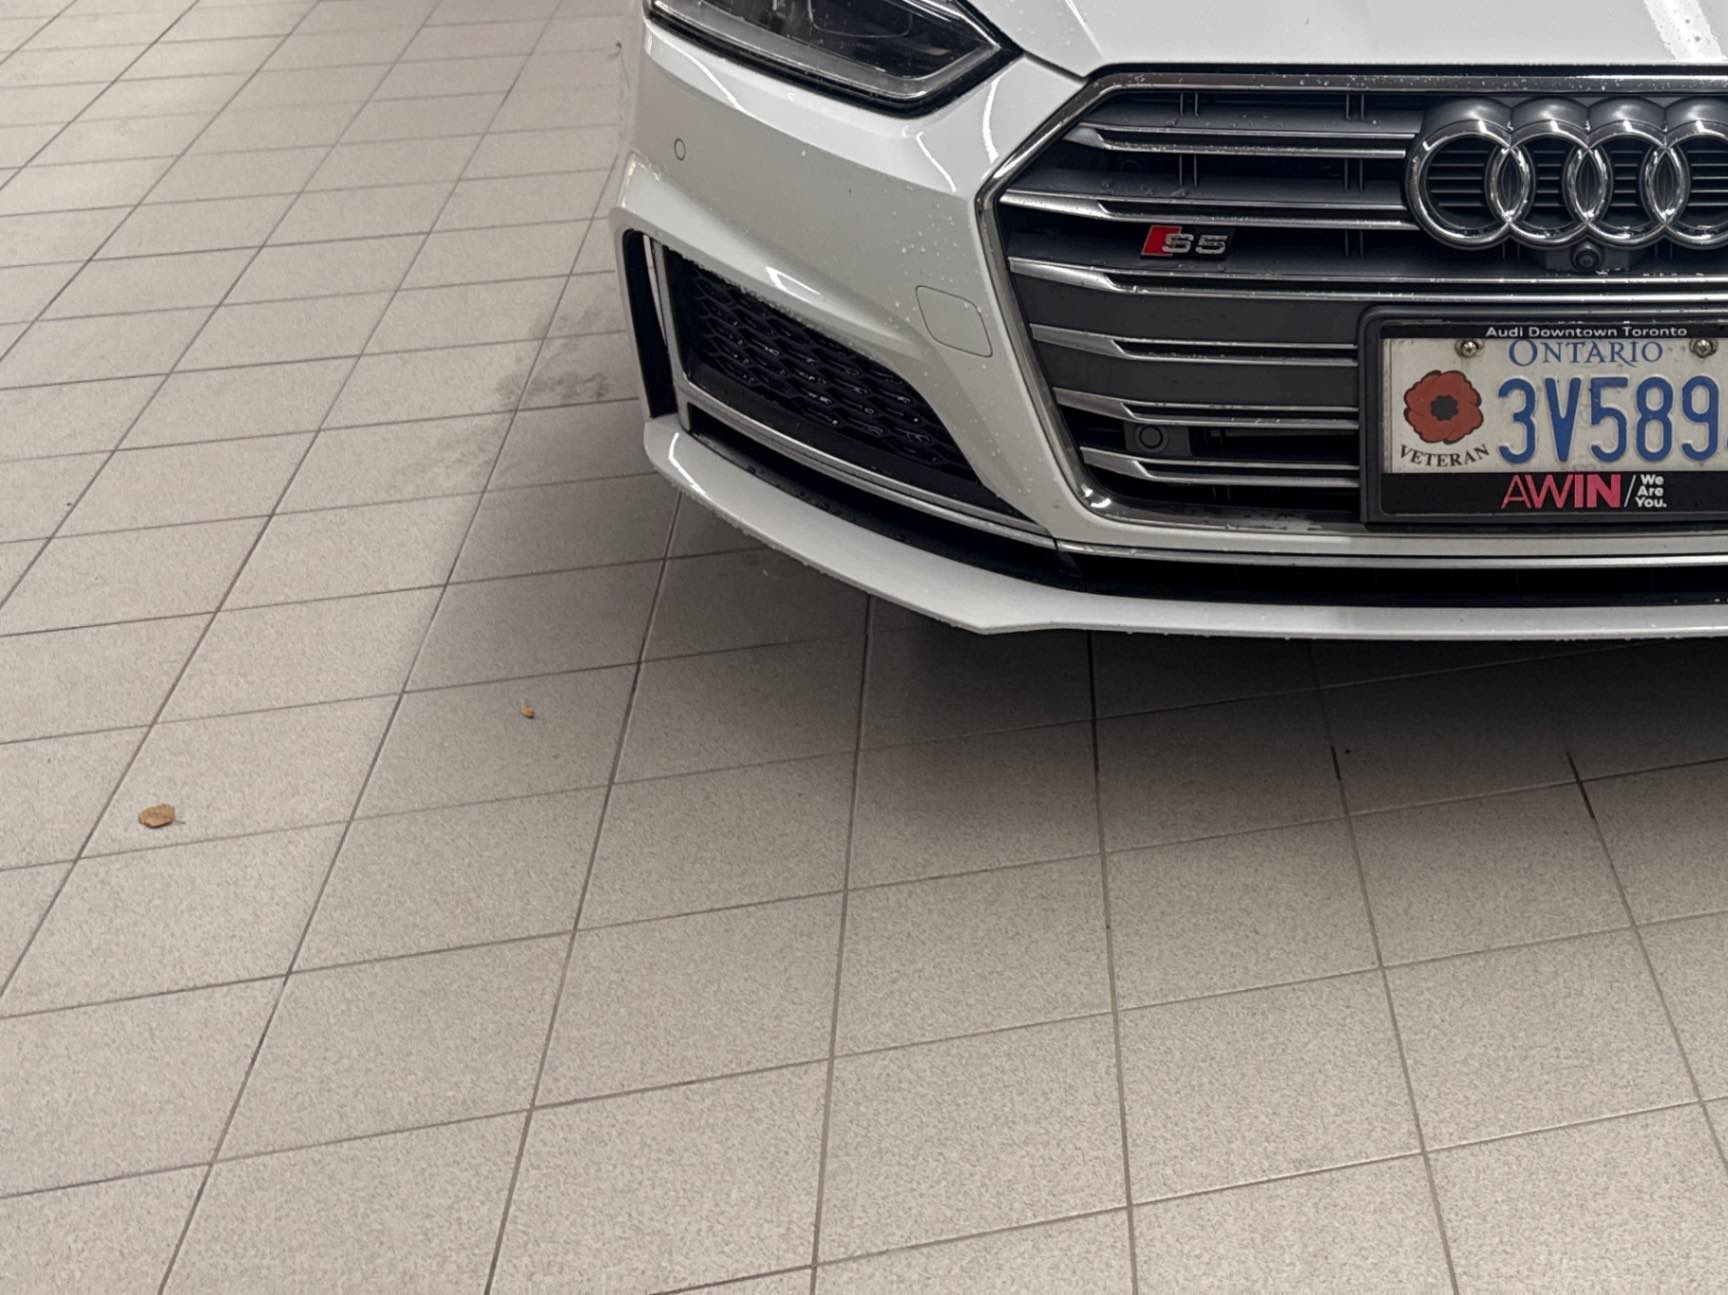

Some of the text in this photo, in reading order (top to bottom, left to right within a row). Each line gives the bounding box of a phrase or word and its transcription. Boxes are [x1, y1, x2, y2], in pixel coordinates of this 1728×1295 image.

[1161, 233, 1229, 255] S5
[1485, 326, 1688, 338] Audi Downtown Toronto
[1508, 339, 1664, 368] ONTARIO
[1400, 443, 1491, 467] VETERAN
[1640, 473, 1665, 485] We
[1500, 473, 1622, 509] AWIN
[1637, 485, 1665, 497] Are
[1634, 497, 1668, 509] You.
